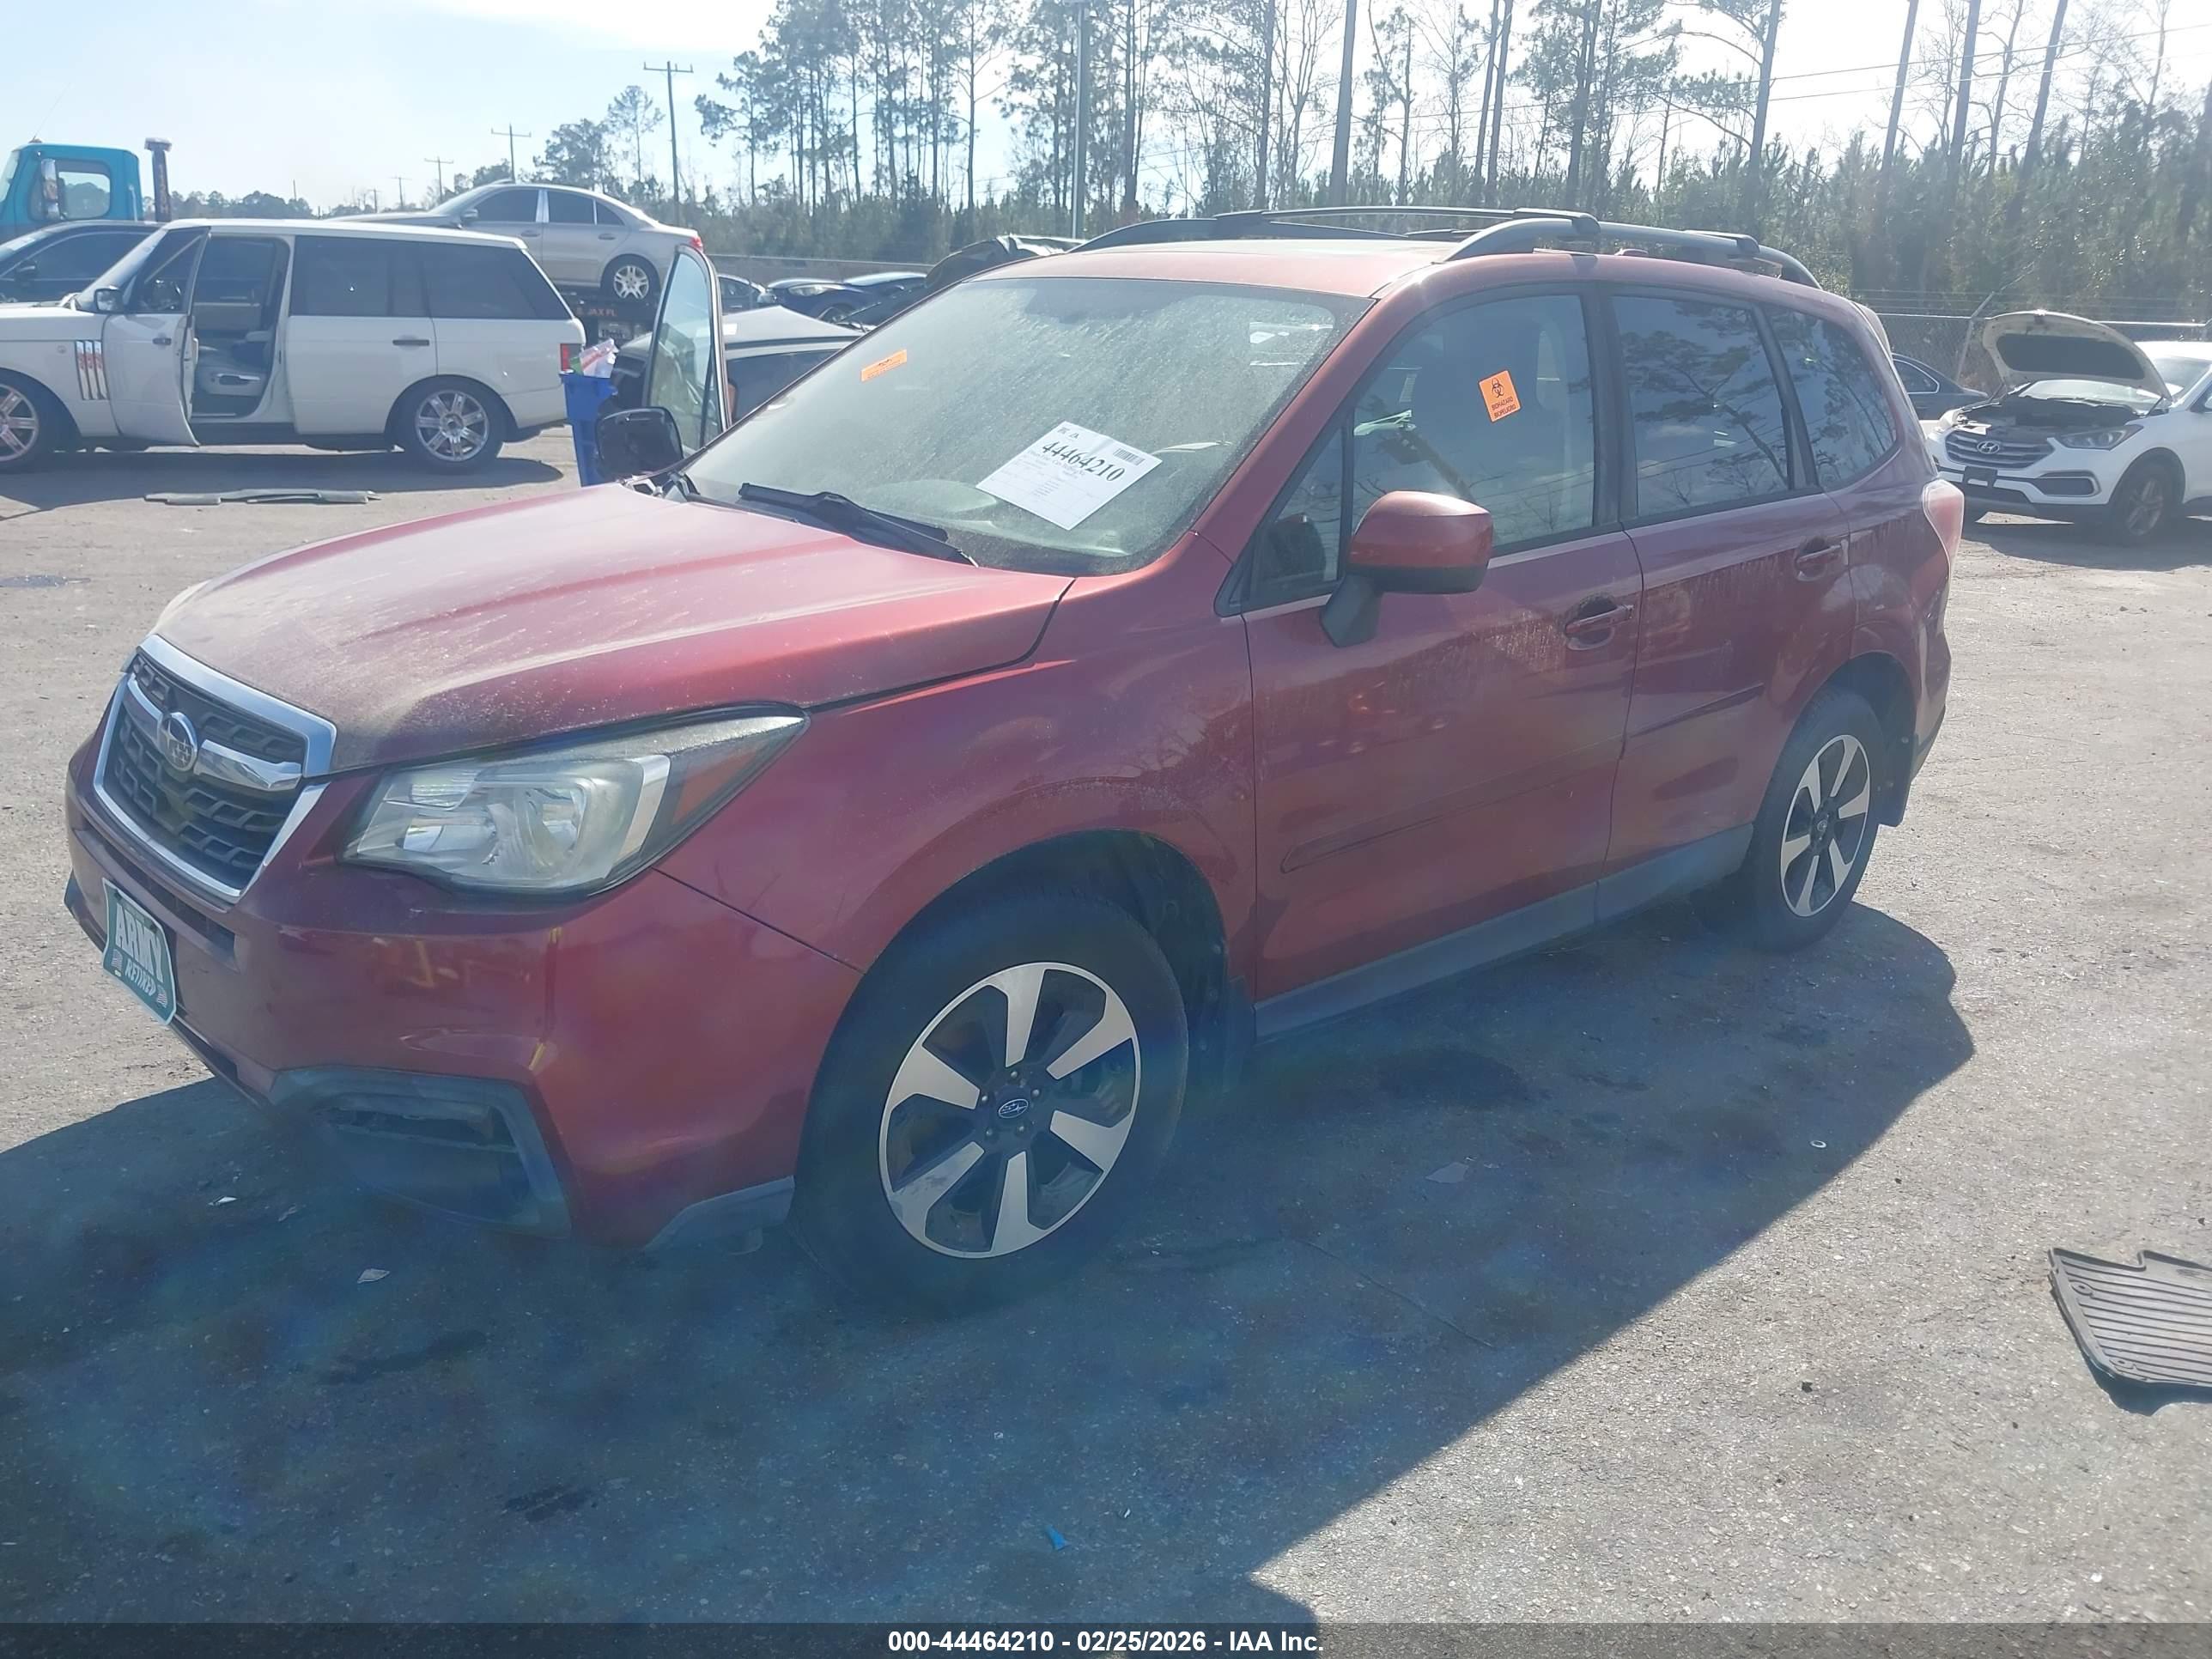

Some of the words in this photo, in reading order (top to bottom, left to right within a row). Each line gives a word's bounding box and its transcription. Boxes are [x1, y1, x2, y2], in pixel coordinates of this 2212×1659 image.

[1042, 441, 1126, 481] 44464210
[115, 902, 164, 983] ARMY
[125, 957, 157, 997] RETIRED
